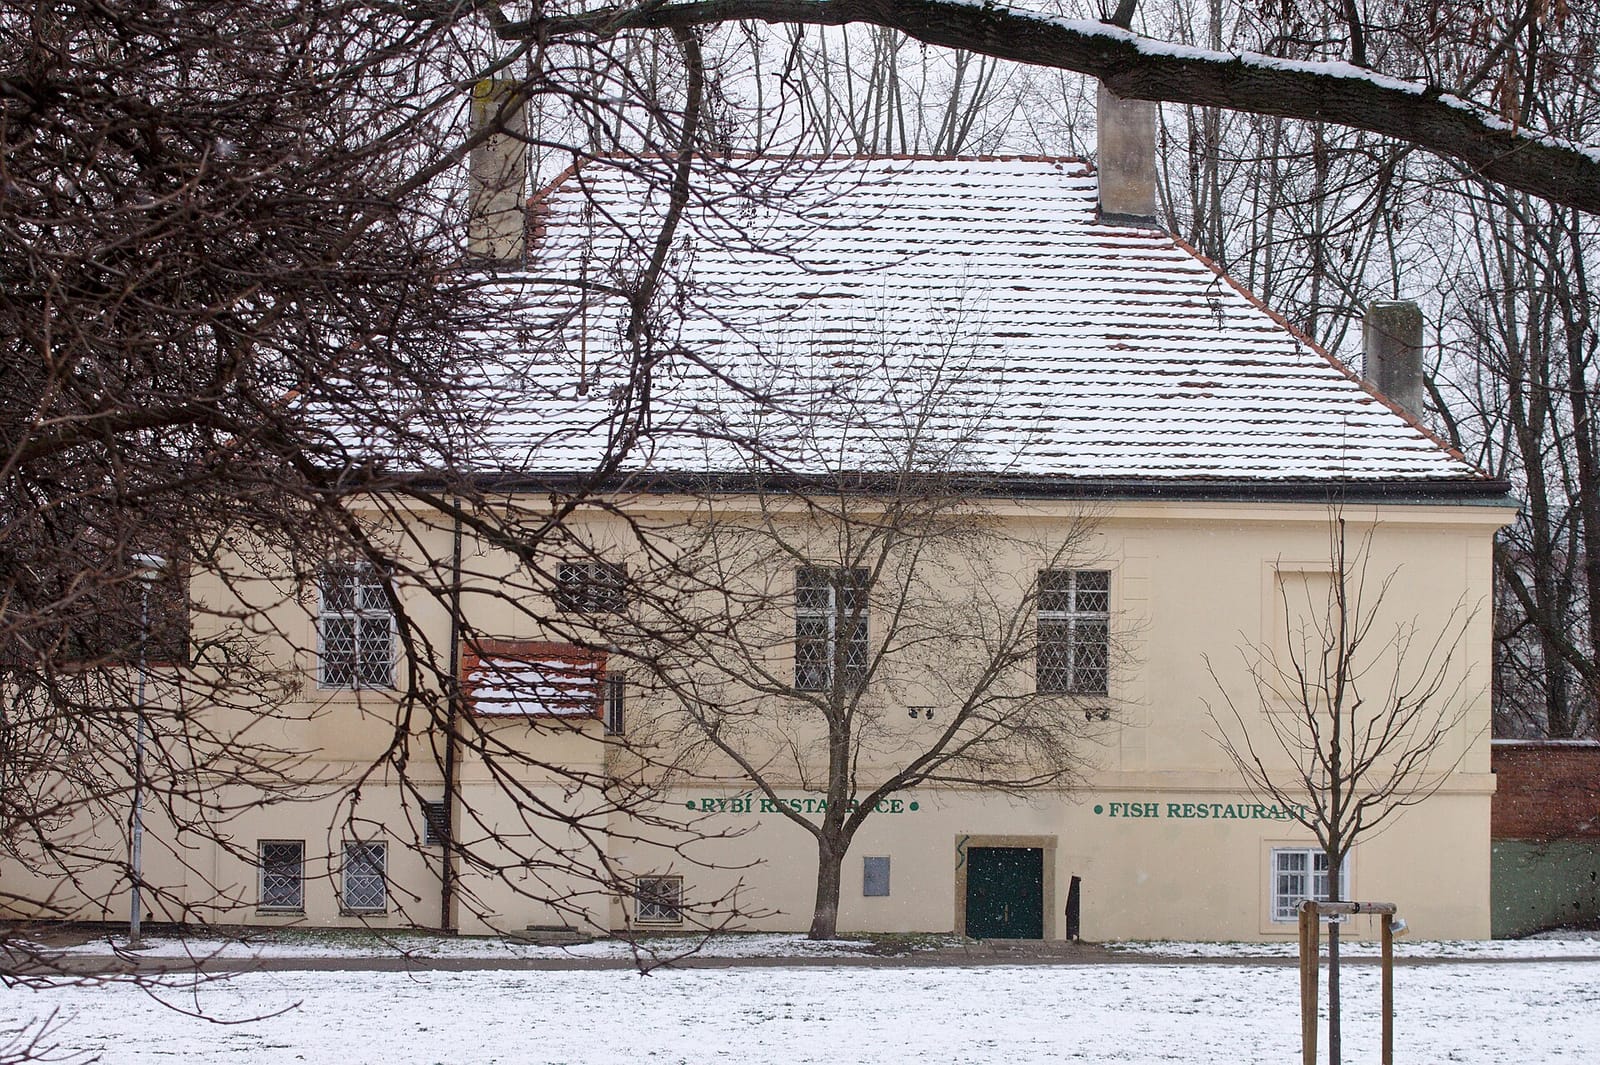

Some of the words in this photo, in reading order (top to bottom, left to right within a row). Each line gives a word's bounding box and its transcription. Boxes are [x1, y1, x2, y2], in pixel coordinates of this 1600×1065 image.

[701, 793, 751, 813] RYBÍ
[759, 798, 904, 814] RSTARCE
[1109, 803, 1159, 818] FISH
[1167, 803, 1309, 819] RESTAURANT
